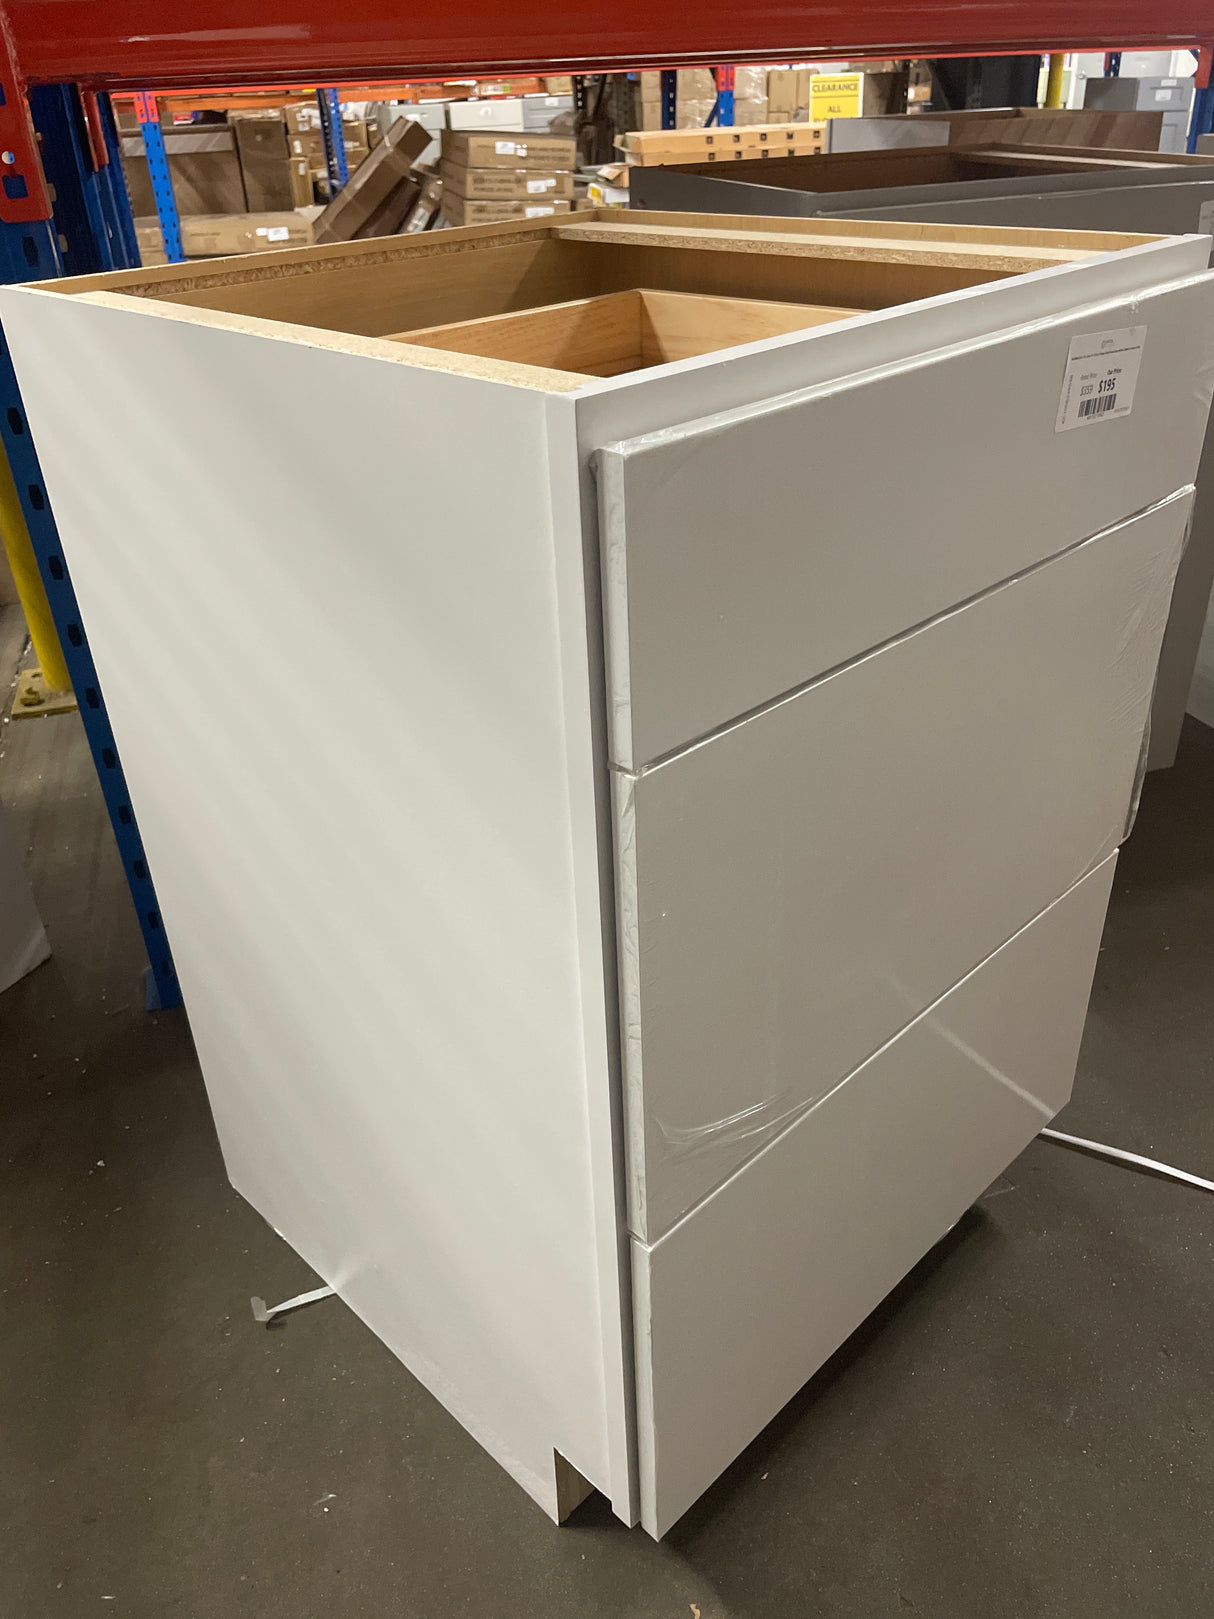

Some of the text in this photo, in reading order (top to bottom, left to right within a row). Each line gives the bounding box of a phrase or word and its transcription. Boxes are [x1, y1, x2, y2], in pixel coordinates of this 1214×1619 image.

[812, 83, 858, 92] CLEARANCE
[828, 105, 841, 113] ALL
[1098, 378, 1116, 393] $195
